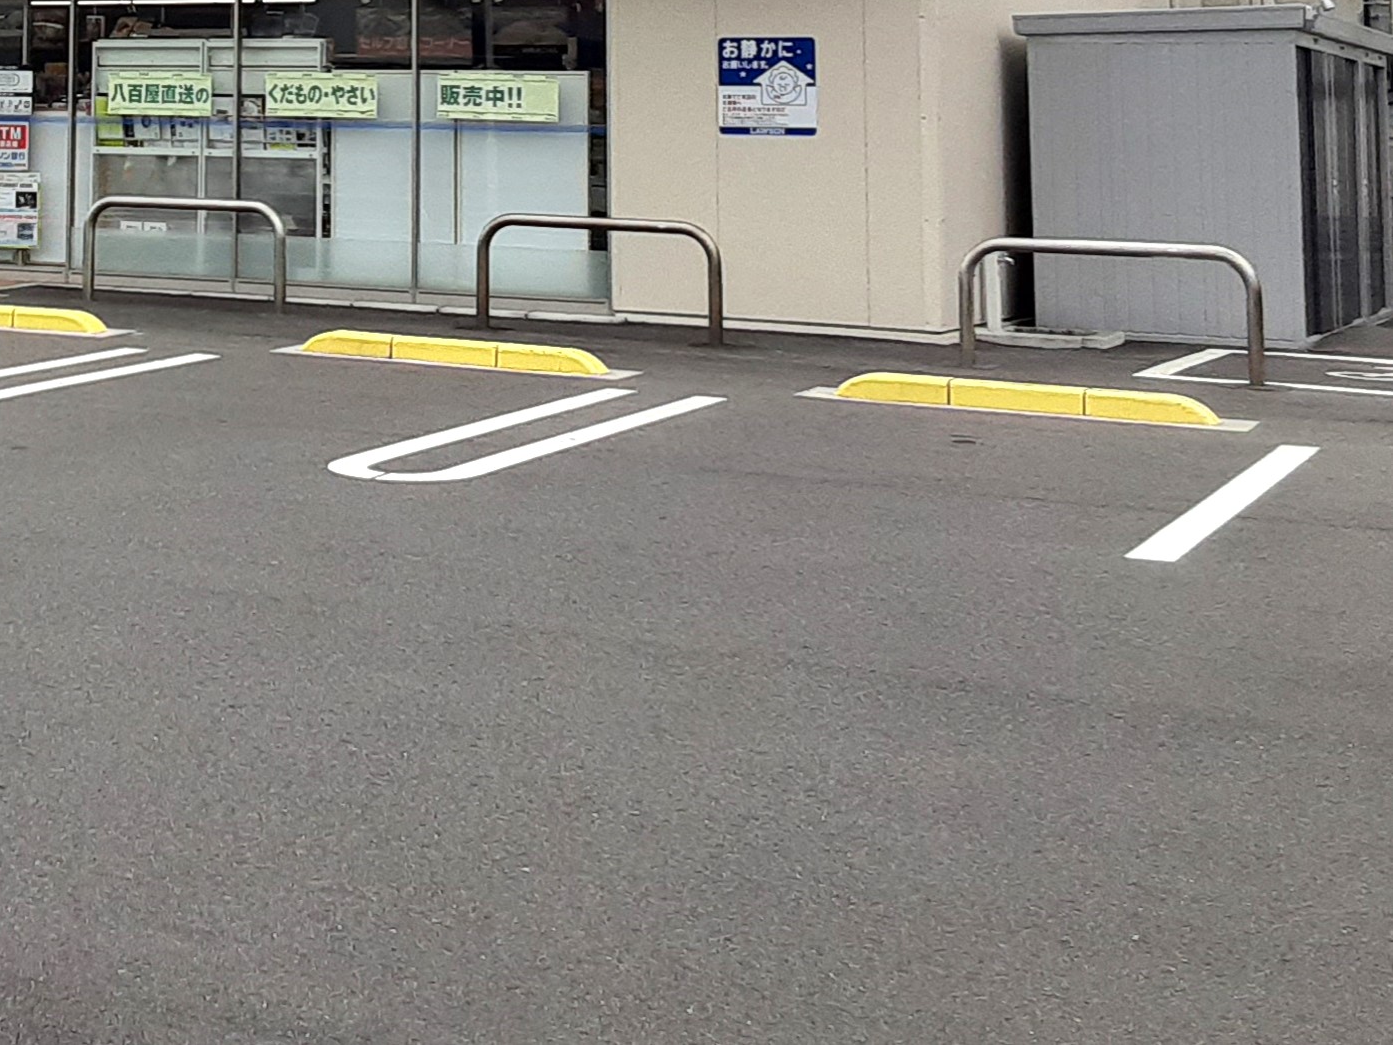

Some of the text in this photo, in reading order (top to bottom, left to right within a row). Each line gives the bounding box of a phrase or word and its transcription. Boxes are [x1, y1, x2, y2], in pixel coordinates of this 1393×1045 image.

[722, 40, 794, 59] お静かに
[111, 83, 209, 105] 八百屋直送の
[268, 83, 375, 106] くだもの・やさい
[440, 84, 522, 108] 販売中!!
